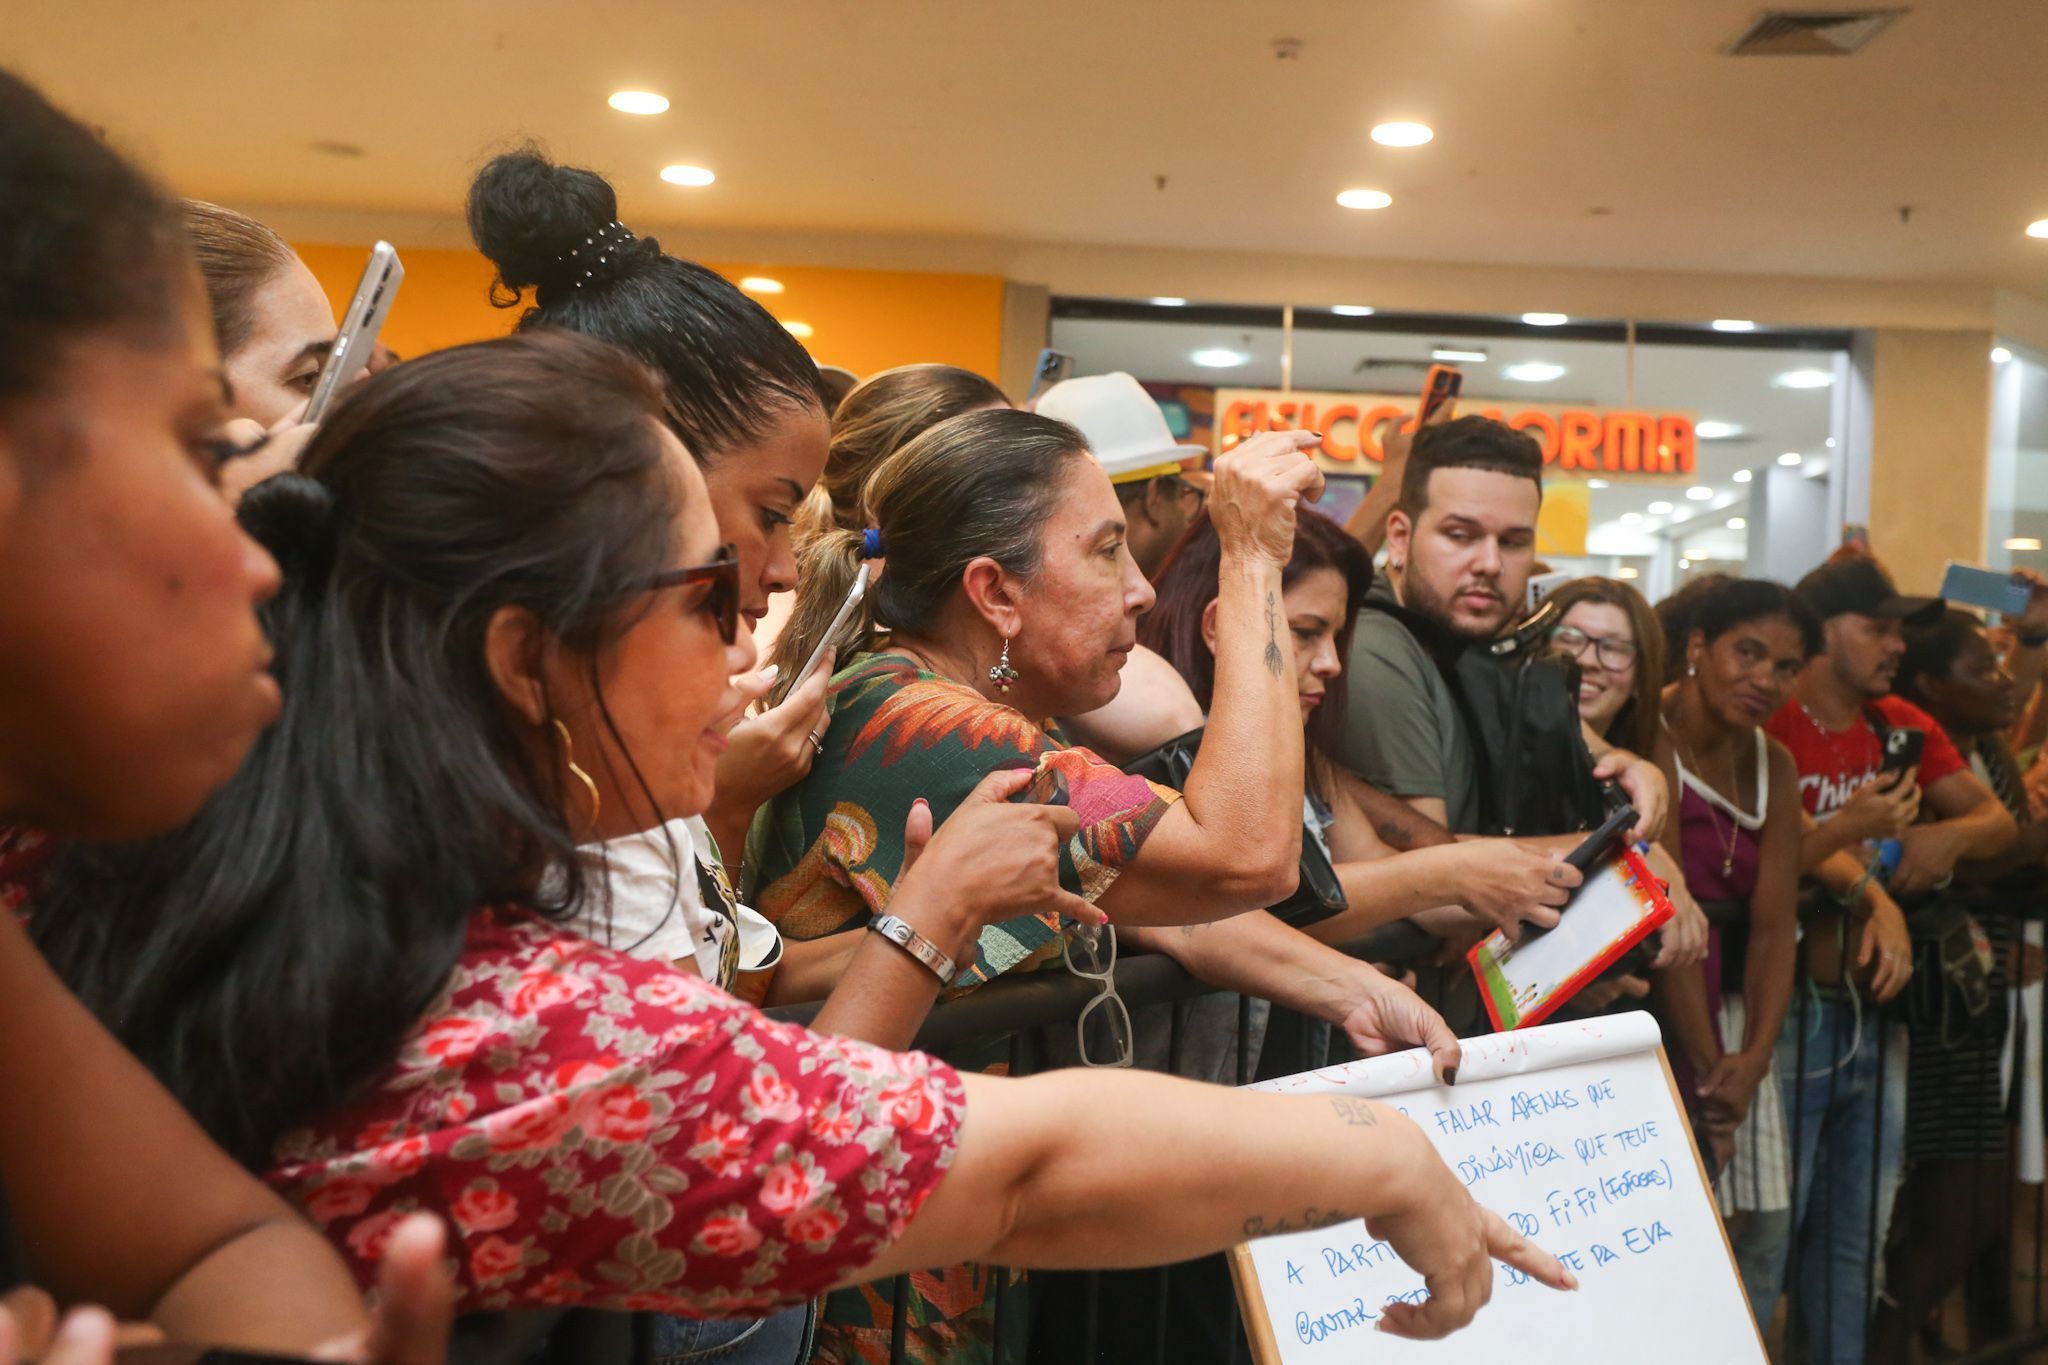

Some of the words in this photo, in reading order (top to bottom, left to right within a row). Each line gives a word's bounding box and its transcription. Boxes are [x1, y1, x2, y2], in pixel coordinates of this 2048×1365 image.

[1480, 408, 1697, 473] ORMA
[1434, 1100, 1501, 1135] FALAR
[1511, 1090, 1580, 1122] APENAS
[1587, 1079, 1616, 1109] QUE
[1574, 1133, 1609, 1166] QUE
[1613, 1120, 1659, 1151] TEVE
[1287, 1259, 1305, 1285] A
[1321, 1242, 1397, 1278] PARTI
[1295, 1297, 1378, 1345] CONTAR
[1622, 1220, 1674, 1254] EVA
